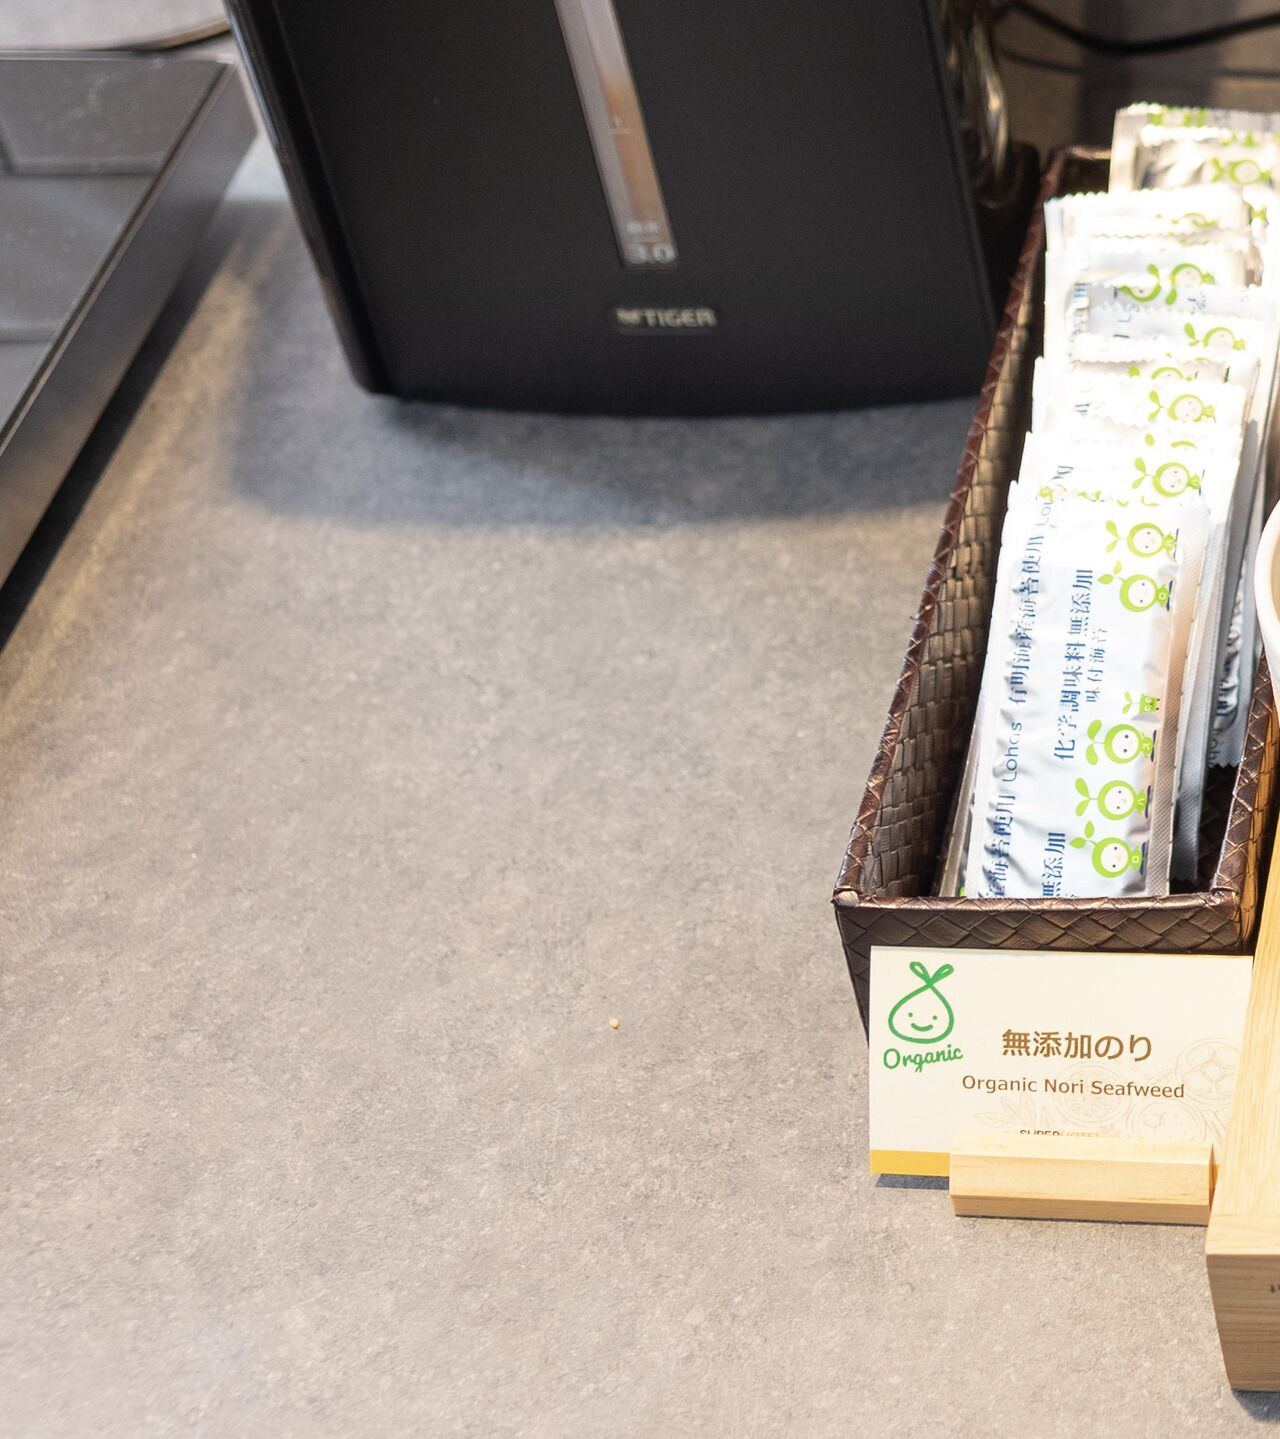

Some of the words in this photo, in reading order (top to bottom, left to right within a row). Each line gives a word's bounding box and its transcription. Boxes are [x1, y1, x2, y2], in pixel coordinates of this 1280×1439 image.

[641, 309, 717, 327] TIGER
[1053, 569, 1093, 761] 化学調味料無添加
[1002, 722, 1022, 782] Lohas
[883, 1044, 963, 1072] Organic
[1002, 1029, 1152, 1062] 無添加のり
[962, 1076, 1038, 1094] Organic
[1044, 1079, 1084, 1094] Nori
[1091, 1081, 1184, 1098] Seafweed
